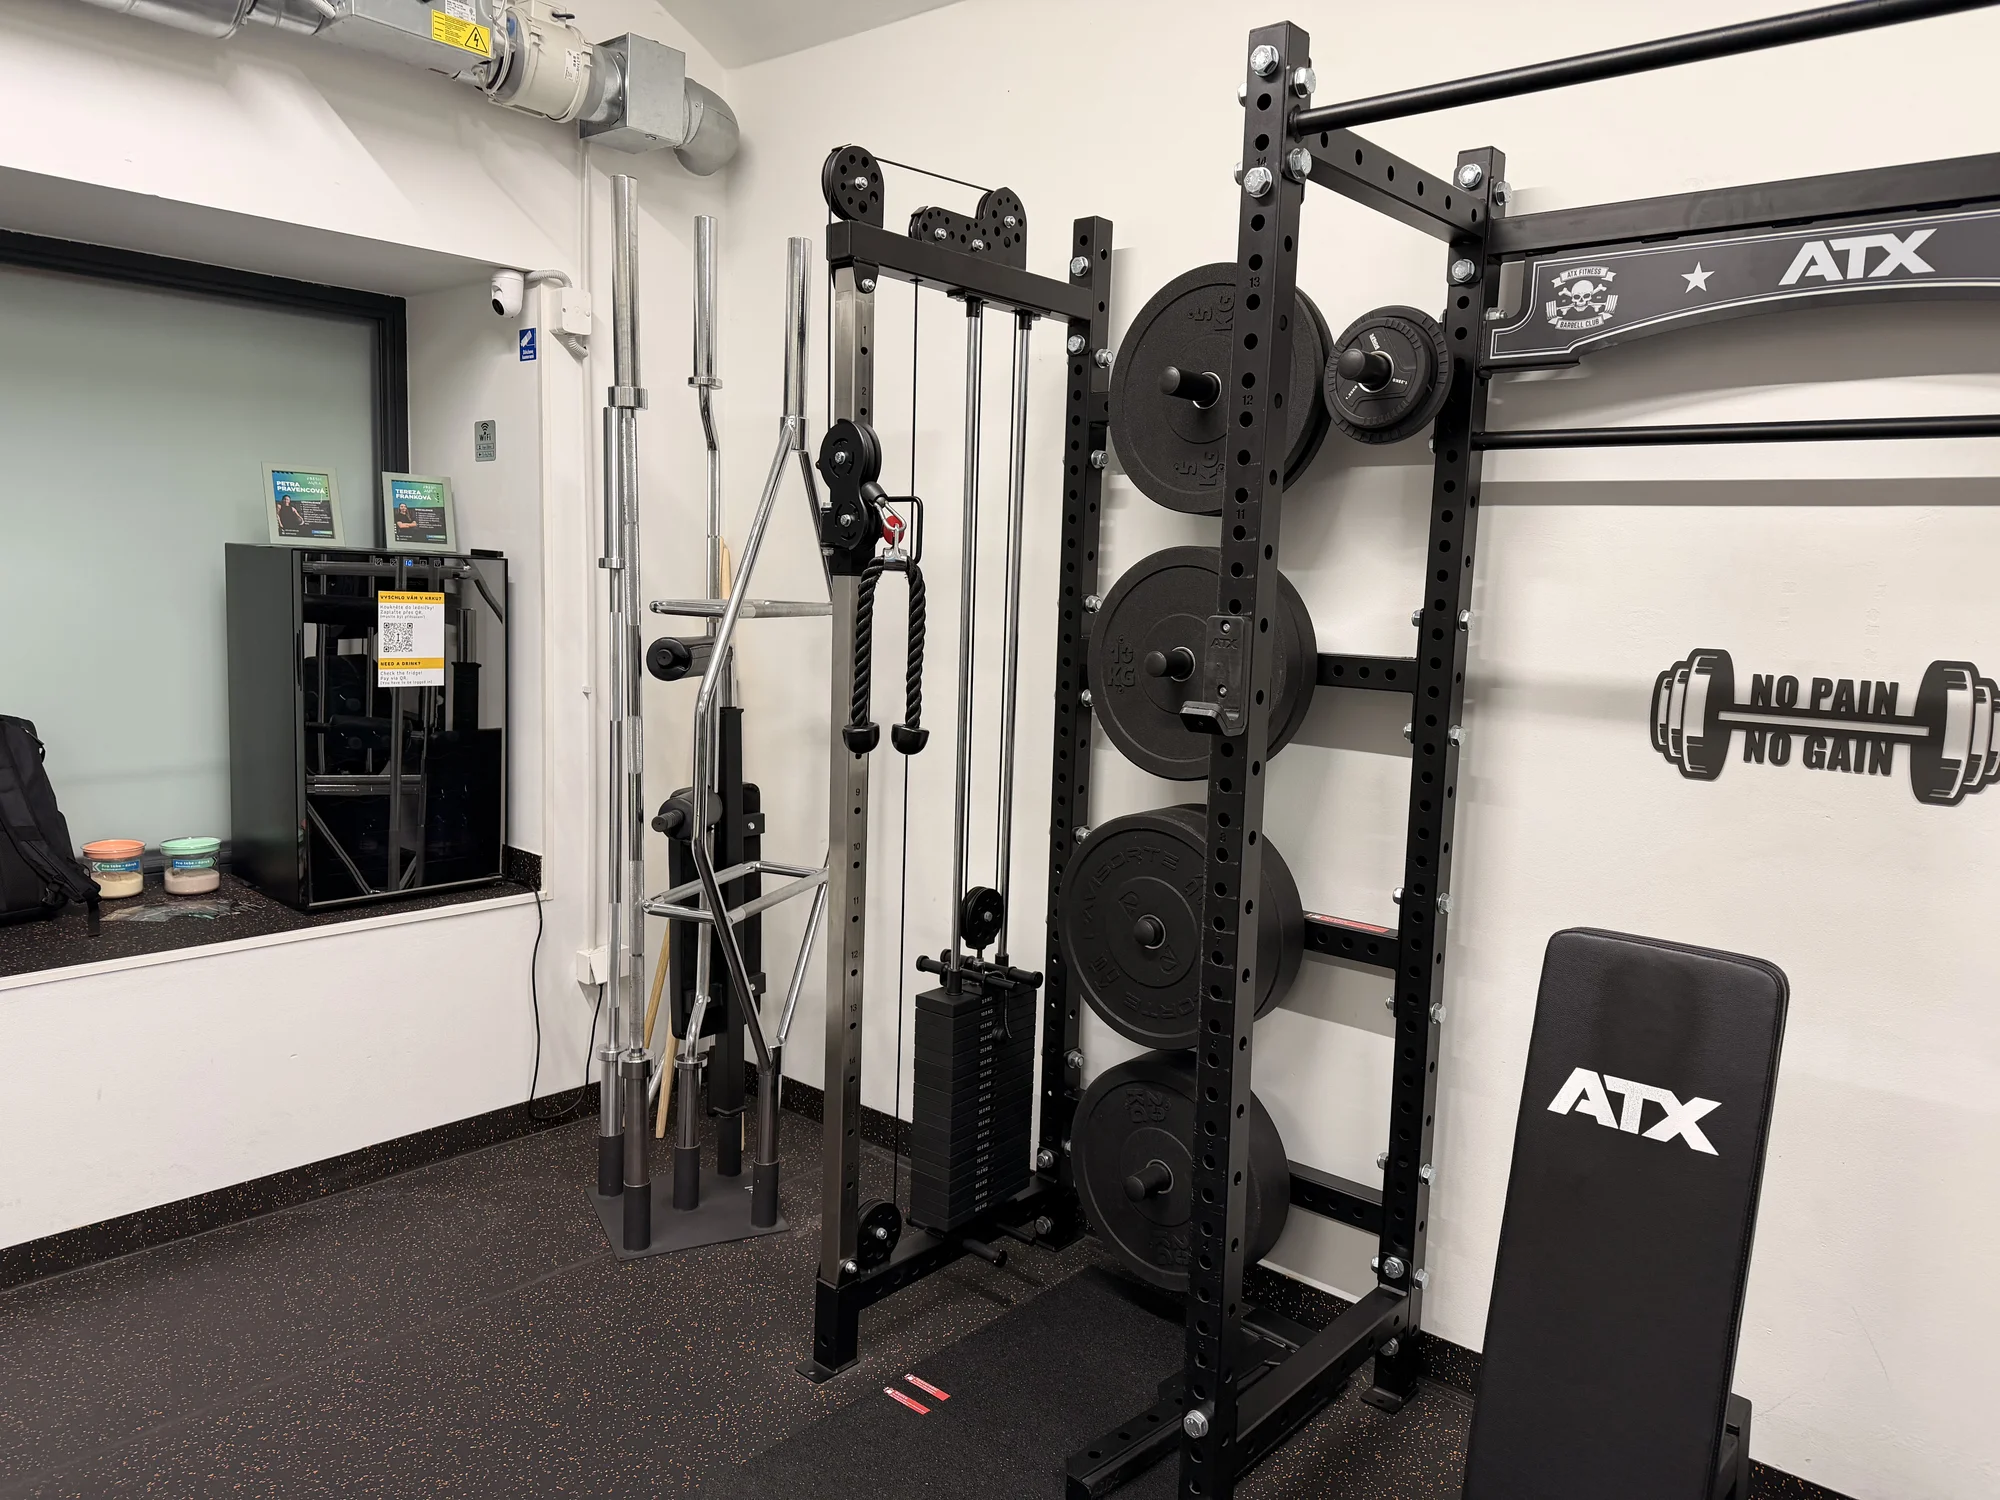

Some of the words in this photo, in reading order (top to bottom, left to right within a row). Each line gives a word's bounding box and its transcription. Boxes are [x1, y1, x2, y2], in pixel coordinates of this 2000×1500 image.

[1777, 227, 1940, 286] ATX
[1567, 270, 1579, 278] ATX
[1579, 268, 1602, 276] FITNESS
[1249, 276, 1260, 288] 13
[1560, 320, 1584, 328] BARBELL
[1586, 318, 1600, 327] CLUB
[861, 386, 867, 396] 2
[1242, 395, 1254, 406] 12
[276, 486, 326, 494] PRAVENCOVÁ
[1236, 508, 1246, 520] 11
[1210, 637, 1238, 650] ATX
[1108, 666, 1136, 687] KG
[1750, 673, 1799, 709] NO
[1810, 677, 1899, 717] PAIN
[1743, 729, 1792, 766] NO
[1803, 734, 1895, 777] GAIN
[855, 788, 861, 797] 9
[853, 842, 860, 851] 10
[853, 896, 859, 905] 11
[851, 950, 859, 959] 12
[1547, 1066, 1723, 1156] ATX
